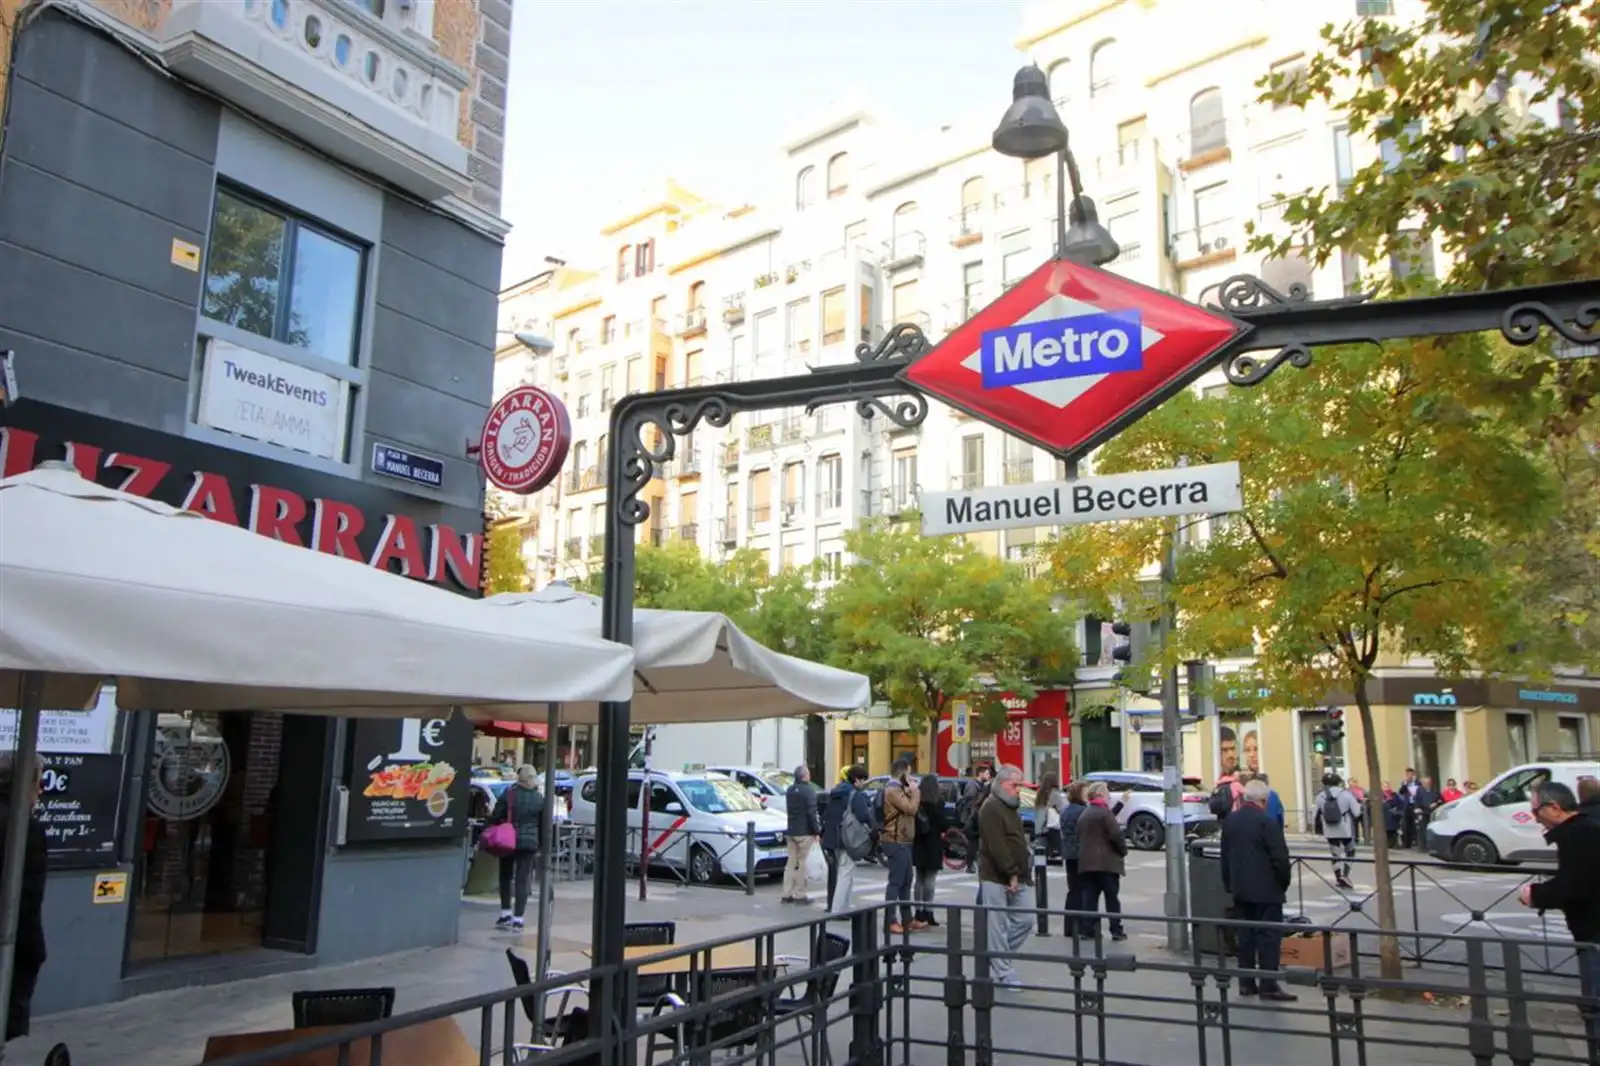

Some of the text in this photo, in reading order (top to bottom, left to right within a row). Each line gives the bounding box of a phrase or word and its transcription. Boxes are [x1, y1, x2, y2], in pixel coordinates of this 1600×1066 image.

[993, 328, 1130, 374] Metro
[223, 360, 328, 407] TweakEventS
[488, 394, 554, 442] LIZARRAN
[386, 460, 440, 483] MANUEL BECERRA
[946, 480, 1208, 525] Manuel Becerra
[65, 756, 83, 766] PAN
